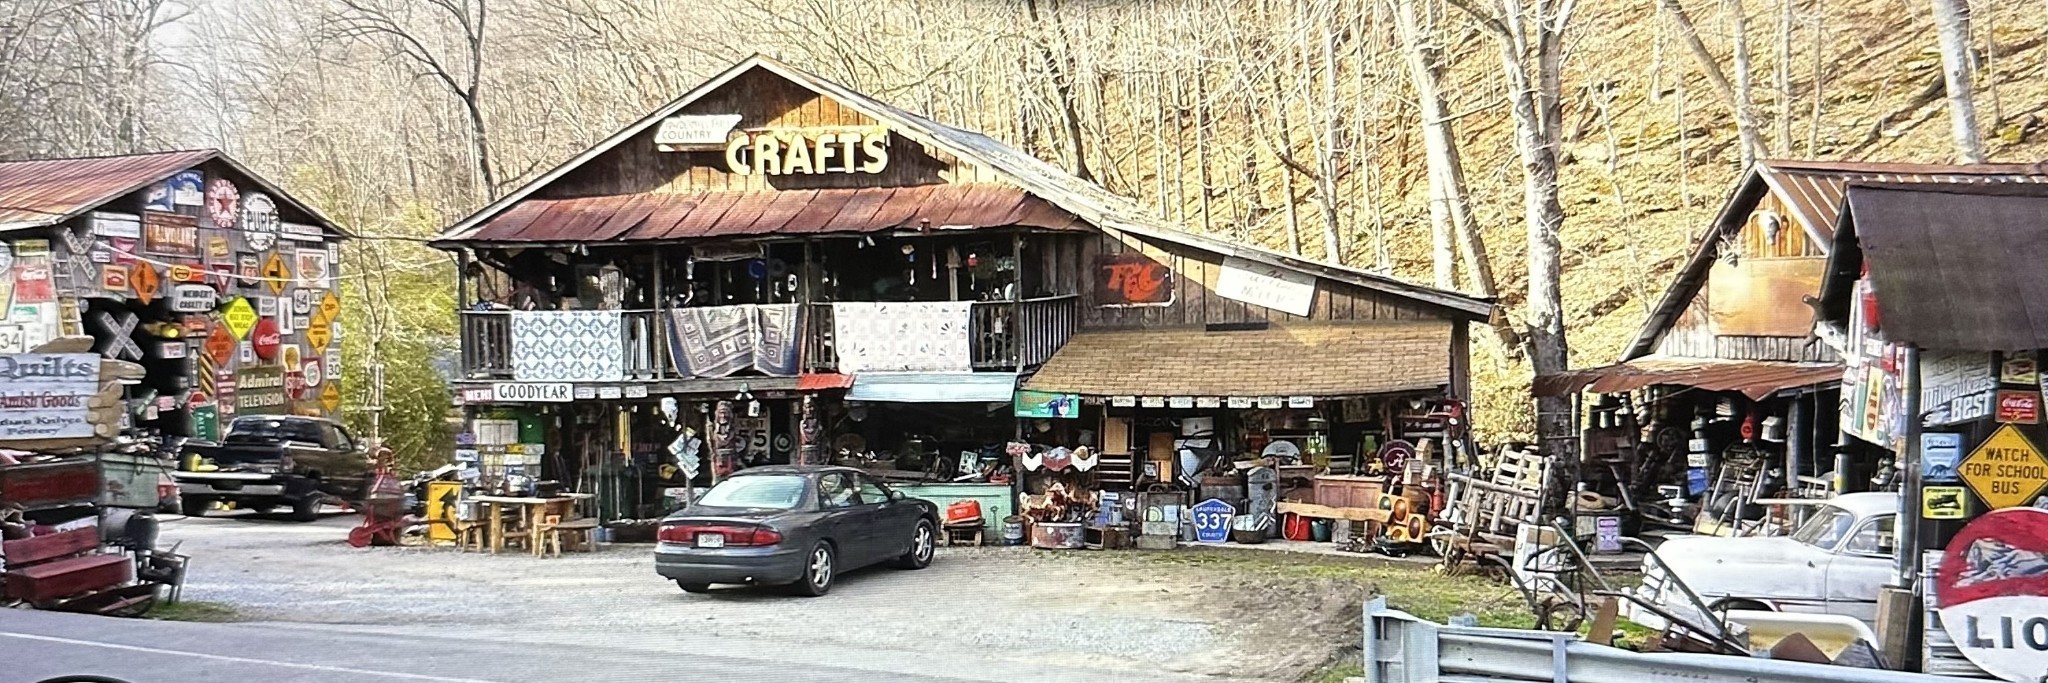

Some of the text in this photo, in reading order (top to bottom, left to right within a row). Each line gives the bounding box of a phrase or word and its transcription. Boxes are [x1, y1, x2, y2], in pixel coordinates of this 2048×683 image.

[662, 130, 712, 140] COUNTRY
[725, 131, 889, 176] CRAFTS
[0, 356, 95, 379] Quilts
[328, 364, 340, 376] 30
[239, 373, 284, 390] Admiral
[0, 390, 81, 408] Amish Goods
[239, 392, 285, 408] TELEVISION
[465, 388, 492, 401] NEHI
[499, 384, 568, 400] GOODYEAR
[1985, 447, 2030, 463] WATCH
[1965, 462, 2047, 481] FOR SCHOOL
[1991, 481, 2020, 495] BUS
[1196, 512, 1232, 530] 337
